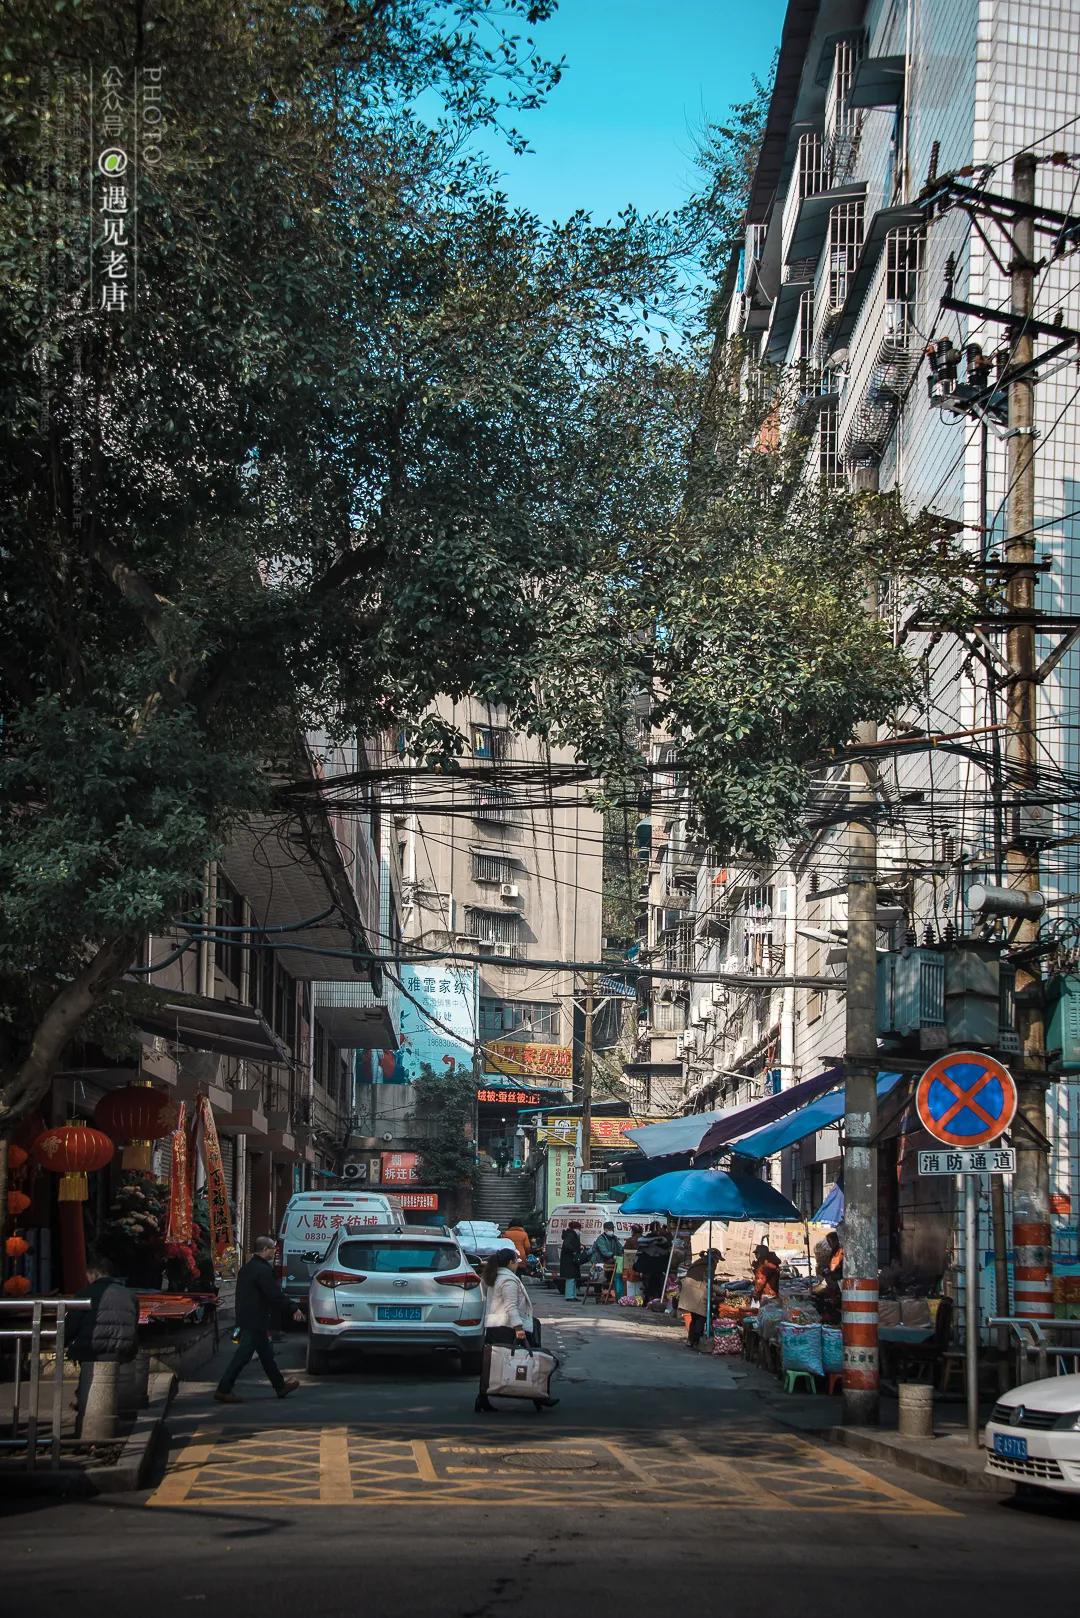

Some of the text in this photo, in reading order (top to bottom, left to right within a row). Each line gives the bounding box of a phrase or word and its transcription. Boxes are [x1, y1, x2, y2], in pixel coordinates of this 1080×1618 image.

[923, 1153, 1012, 1171] 消防通道
[296, 1214, 379, 1229] 八歌家纺城
